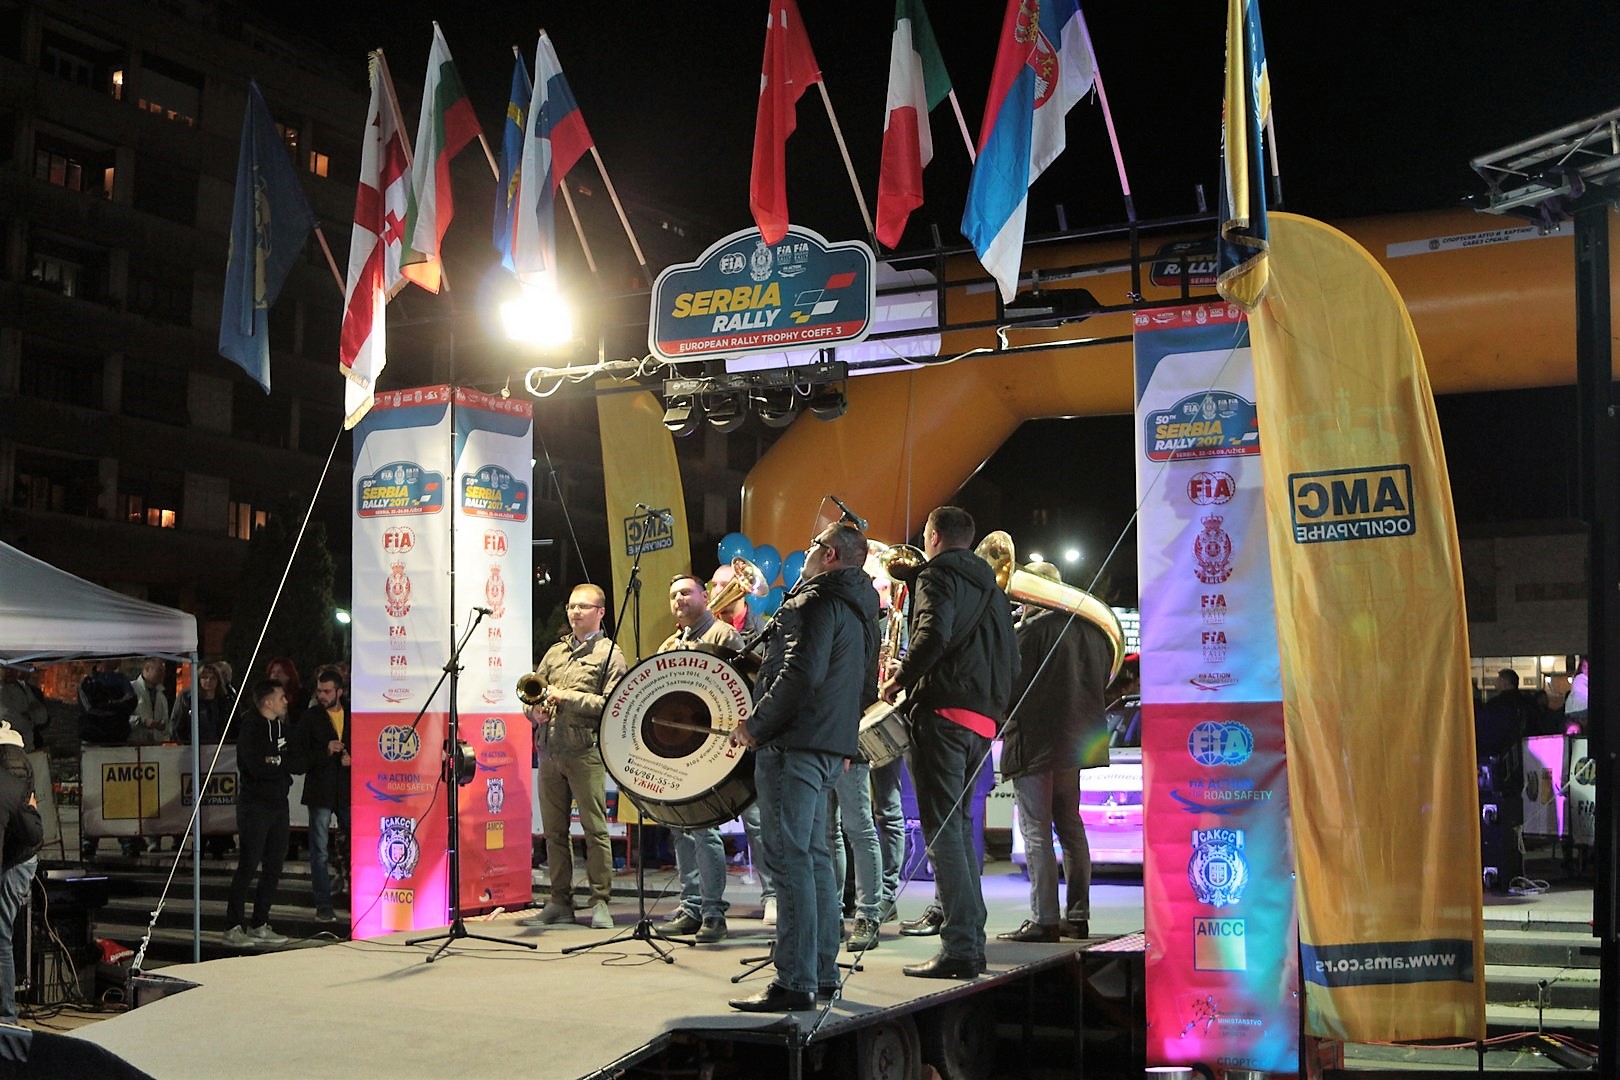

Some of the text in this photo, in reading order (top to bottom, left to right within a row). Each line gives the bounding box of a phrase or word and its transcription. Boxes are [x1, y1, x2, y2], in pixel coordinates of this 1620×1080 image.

[1164, 262, 1217, 274] RLLY
[672, 282, 781, 318] SERBIA
[712, 309, 781, 334] RALLY
[679, 326, 842, 353] EUROPEAN RALLY TROPHY COEFF. 3
[1155, 420, 1222, 439] SERBIA
[1154, 435, 1225, 451] RALLY 2017
[363, 485, 408, 499] SERBIA
[465, 485, 502, 501] SERBIA
[362, 498, 410, 509] RALLY 2017
[464, 497, 488, 508] RALLY
[390, 773, 420, 782] ACTION
[1204, 790, 1233, 800] ROAD
[1234, 790, 1272, 800] SAFETY
